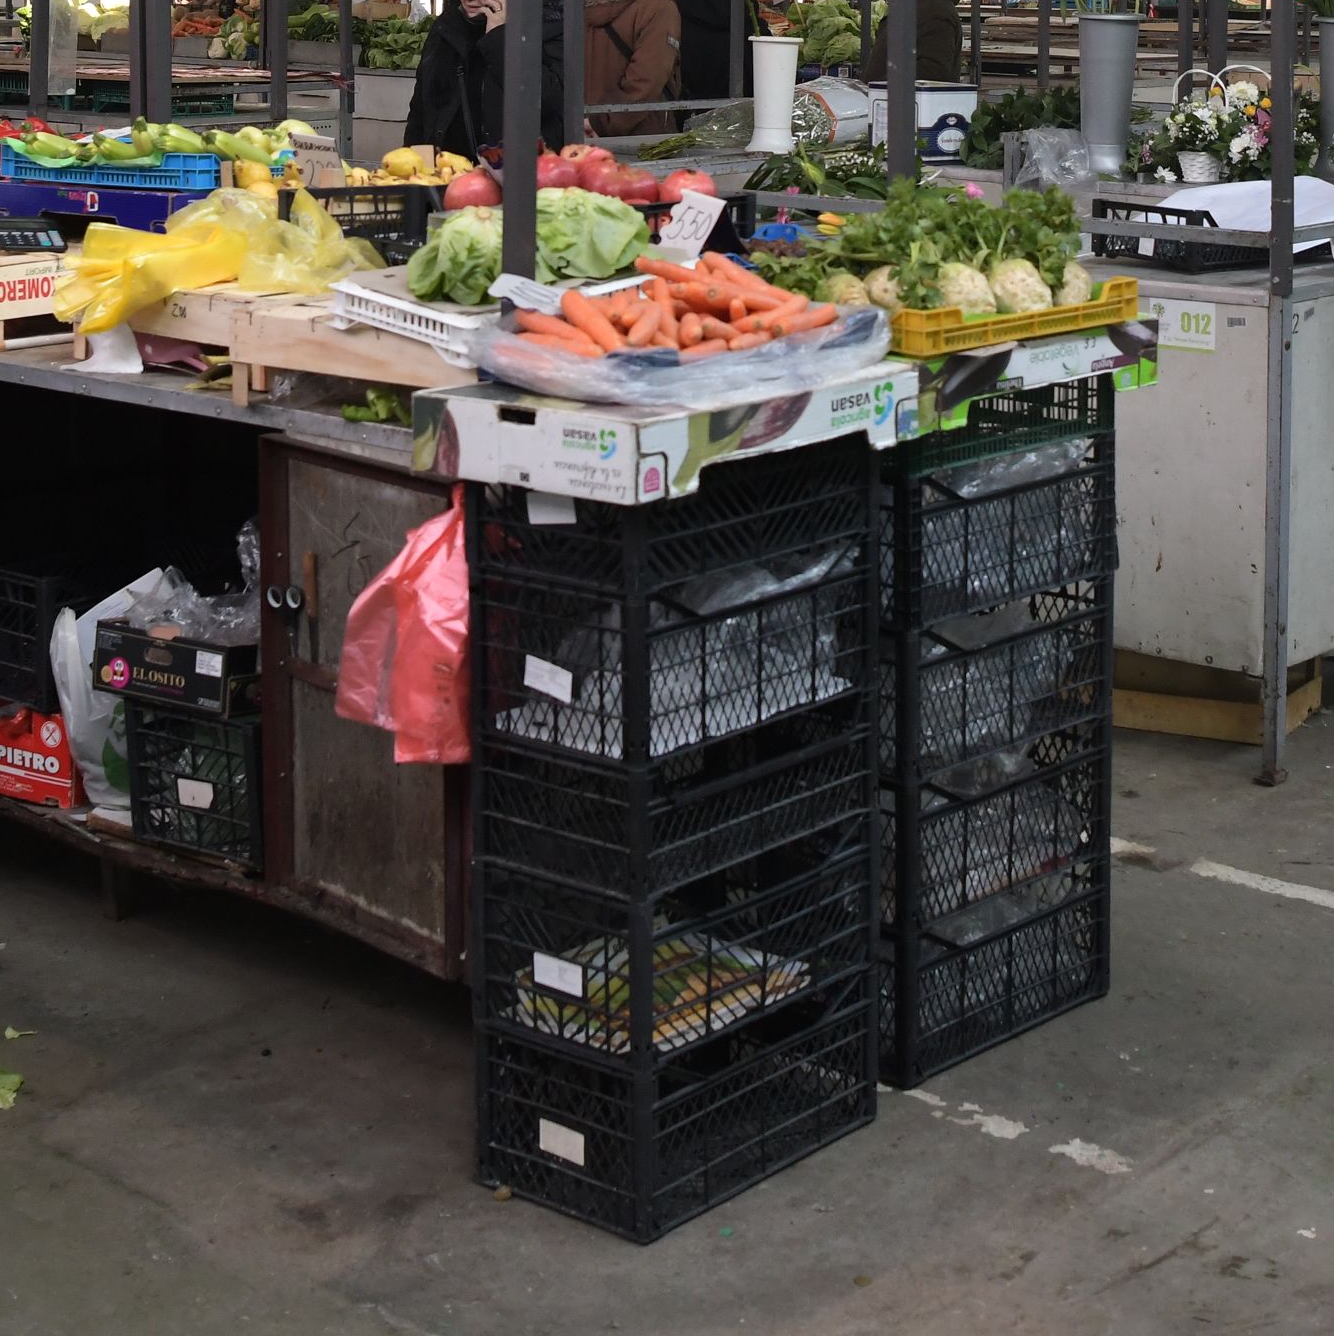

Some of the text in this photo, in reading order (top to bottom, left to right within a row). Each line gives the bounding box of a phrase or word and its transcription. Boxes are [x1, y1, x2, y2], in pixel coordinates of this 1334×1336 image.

[667, 205, 712, 241] 550
[1180, 311, 1212, 336] 012
[831, 392, 871, 412] vasan
[562, 428, 597, 441] vasan
[132, 666, 148, 681] EL
[148, 669, 186, 689] OSITO
